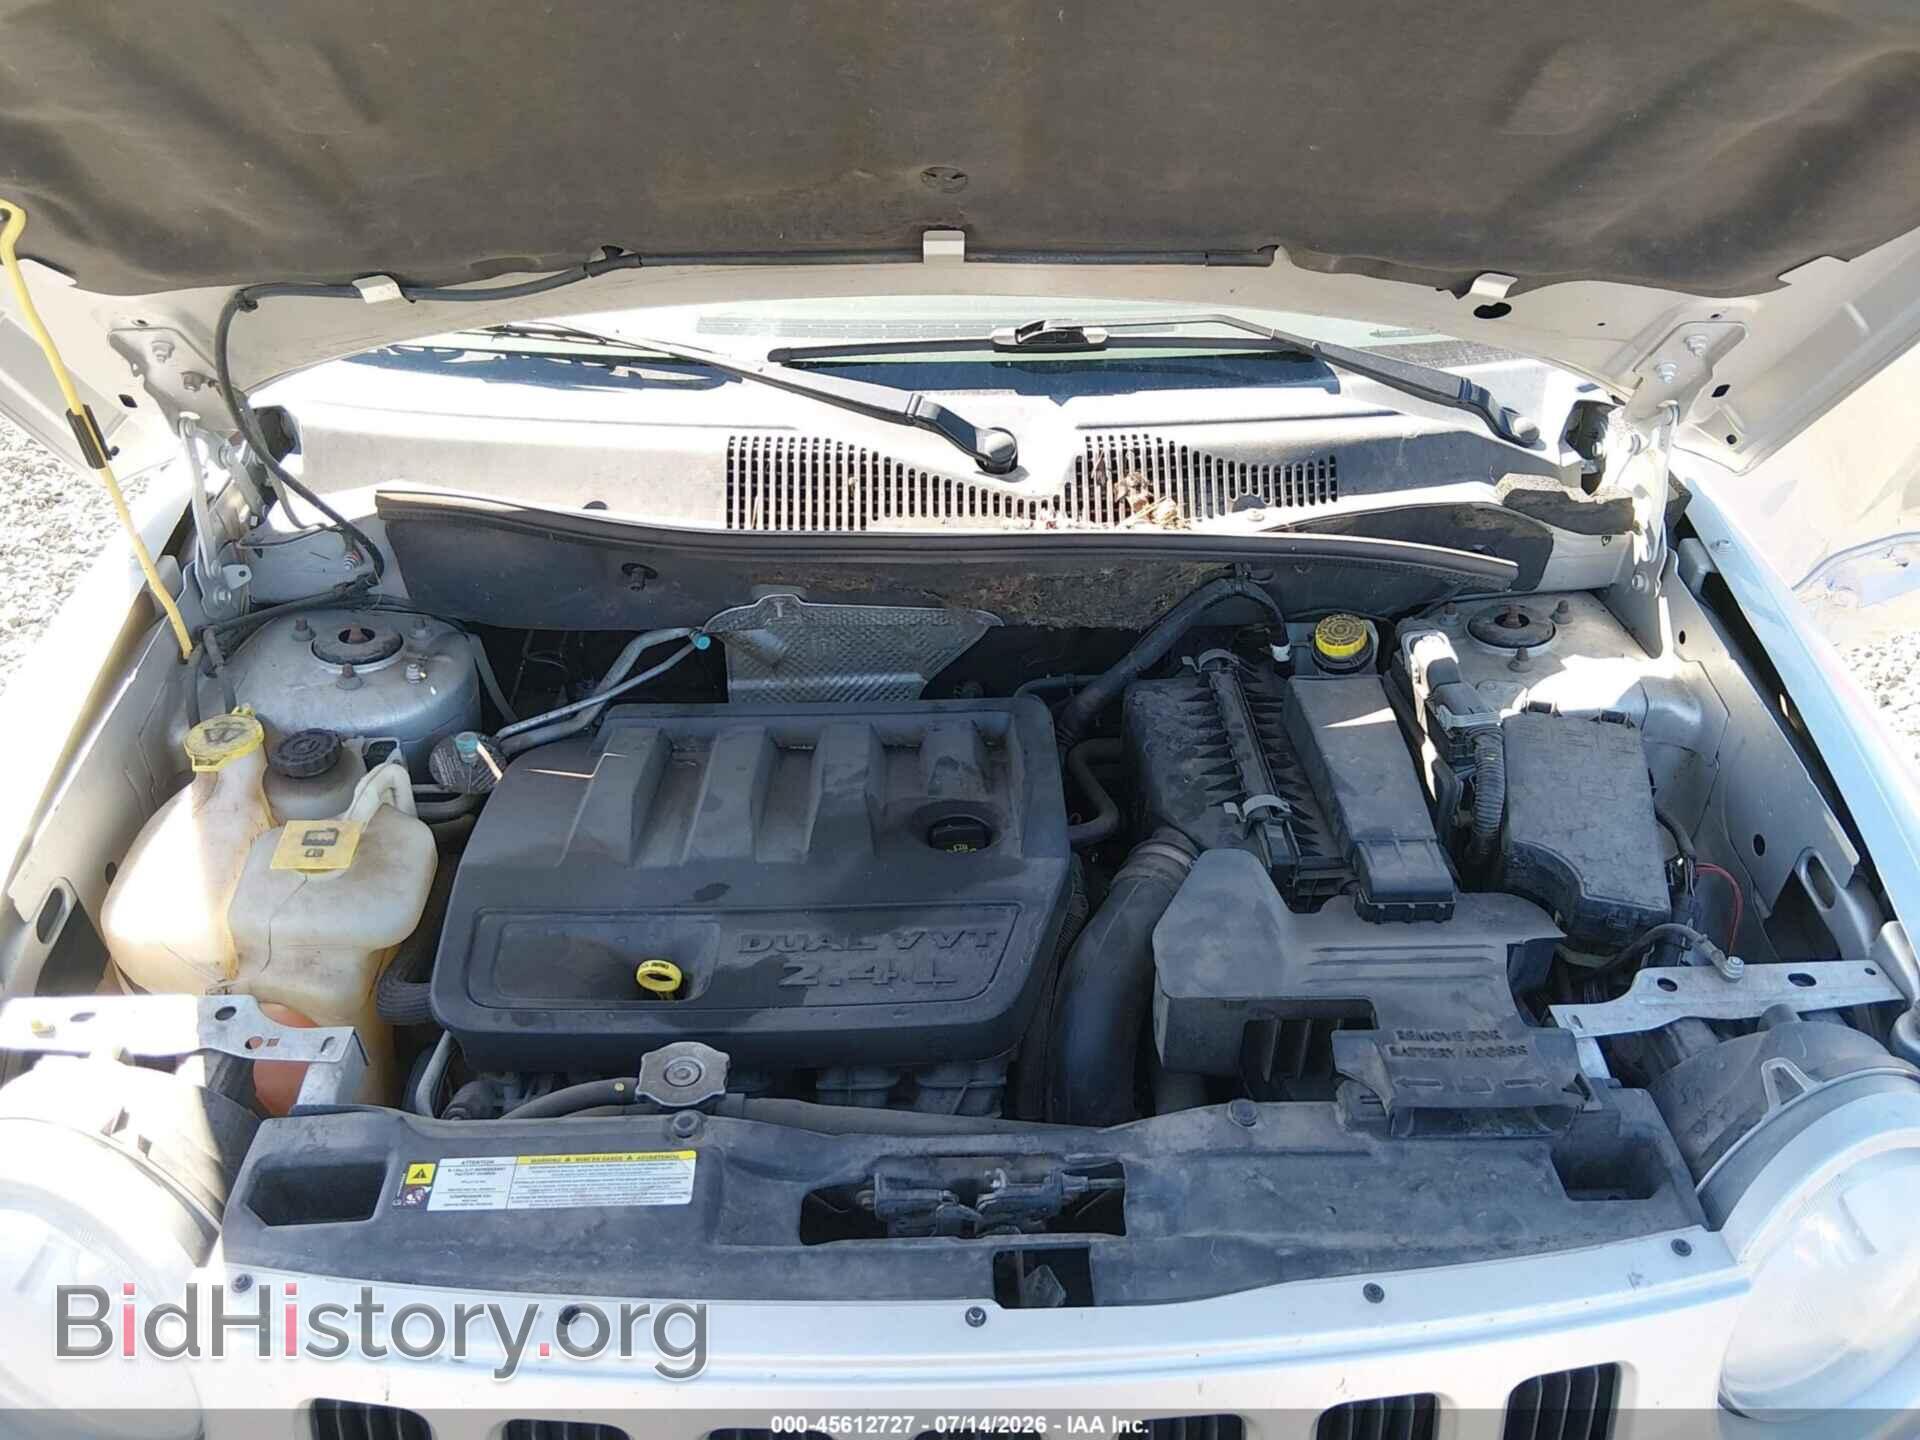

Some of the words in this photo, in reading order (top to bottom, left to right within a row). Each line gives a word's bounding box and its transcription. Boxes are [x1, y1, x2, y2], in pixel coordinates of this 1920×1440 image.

[737, 932, 878, 953] DUAL
[890, 929, 998, 951] VVT
[778, 961, 958, 989] 2.4L
[1394, 1029, 1464, 1042] REMOVE
[1468, 1029, 1503, 1041] FOR
[1387, 1045, 1457, 1058] BATTERY
[1463, 1044, 1529, 1058] ACCESS
